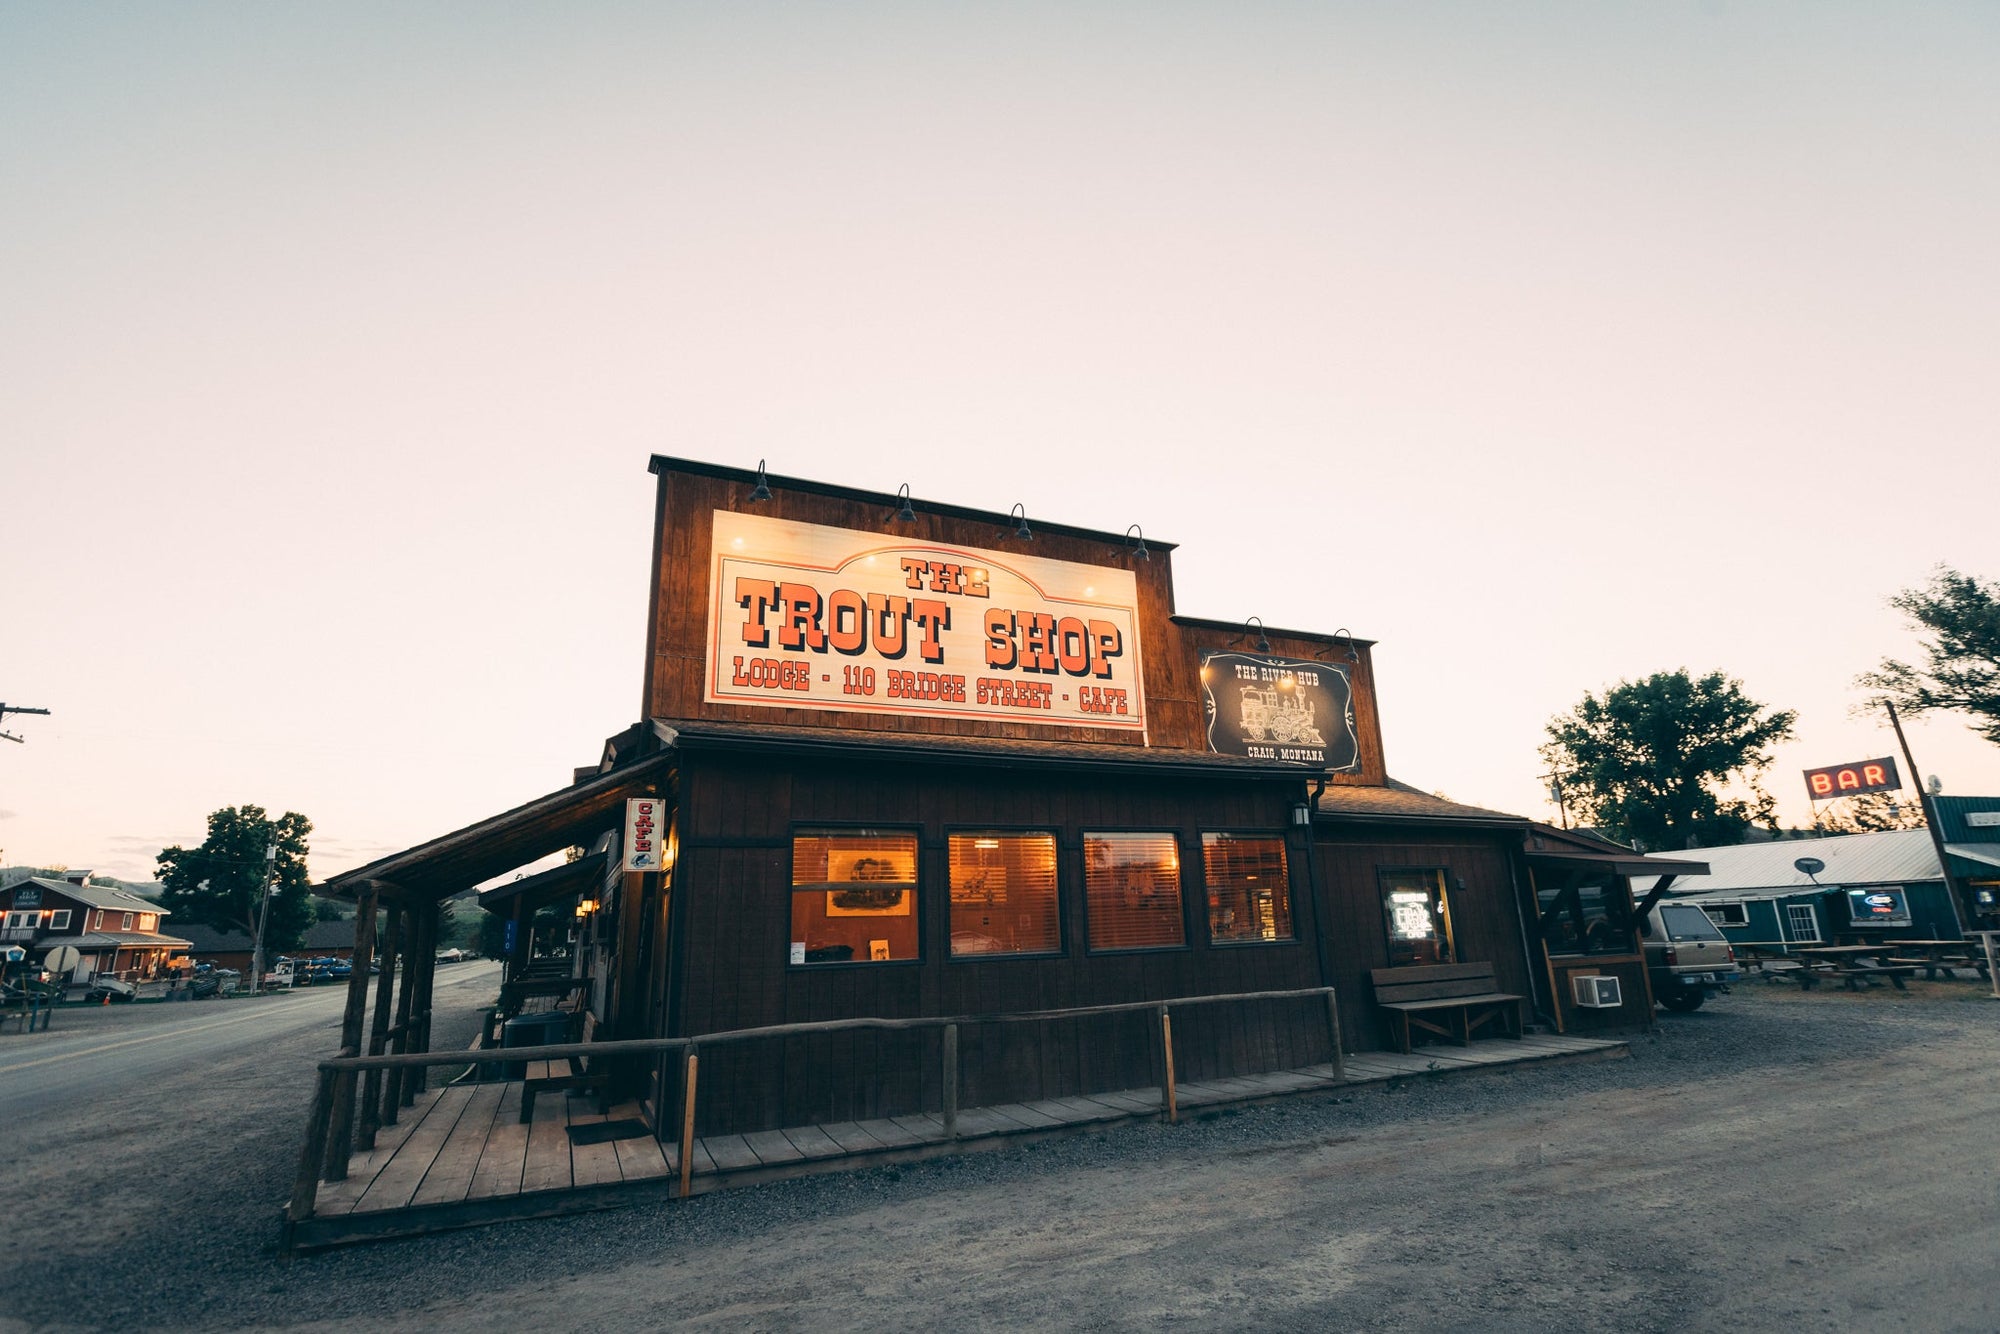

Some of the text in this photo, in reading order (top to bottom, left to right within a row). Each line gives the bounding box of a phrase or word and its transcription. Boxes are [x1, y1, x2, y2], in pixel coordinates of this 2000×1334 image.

[900, 557, 990, 598] THE
[735, 576, 1123, 679] TROUT SHOP
[732, 656, 1127, 714] LODGE 110 BRIDGE STREET CAFE
[1235, 665, 1319, 687] THE RIVER HUB
[1248, 746, 1325, 762] CRAIG, MONTANA
[1810, 765, 1886, 794] BAR
[635, 802, 655, 852] CAFE
